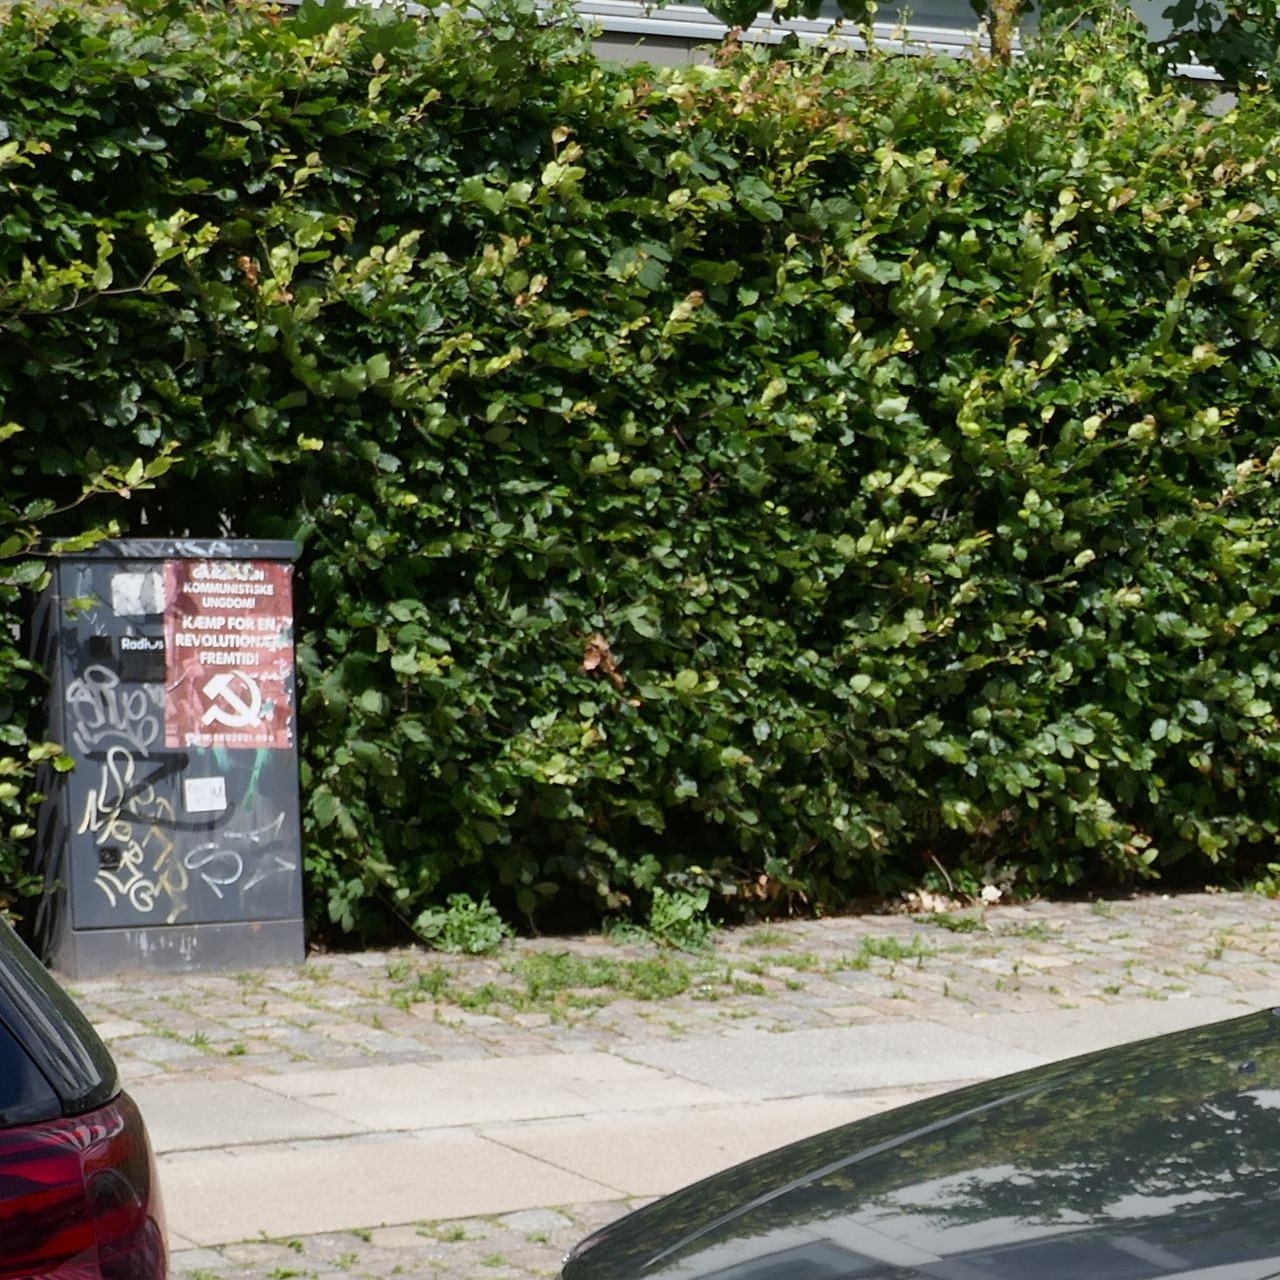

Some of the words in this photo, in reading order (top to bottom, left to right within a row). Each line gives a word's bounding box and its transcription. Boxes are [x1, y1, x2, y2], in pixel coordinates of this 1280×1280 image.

[183, 581, 275, 596] KOMMUNISTISKE
[202, 596, 257, 609] UNGDOM!
[182, 616, 226, 630] KÆMP
[227, 617, 255, 631] FOR
[121, 637, 164, 650] Radius
[200, 651, 260, 666] FREMTID!
